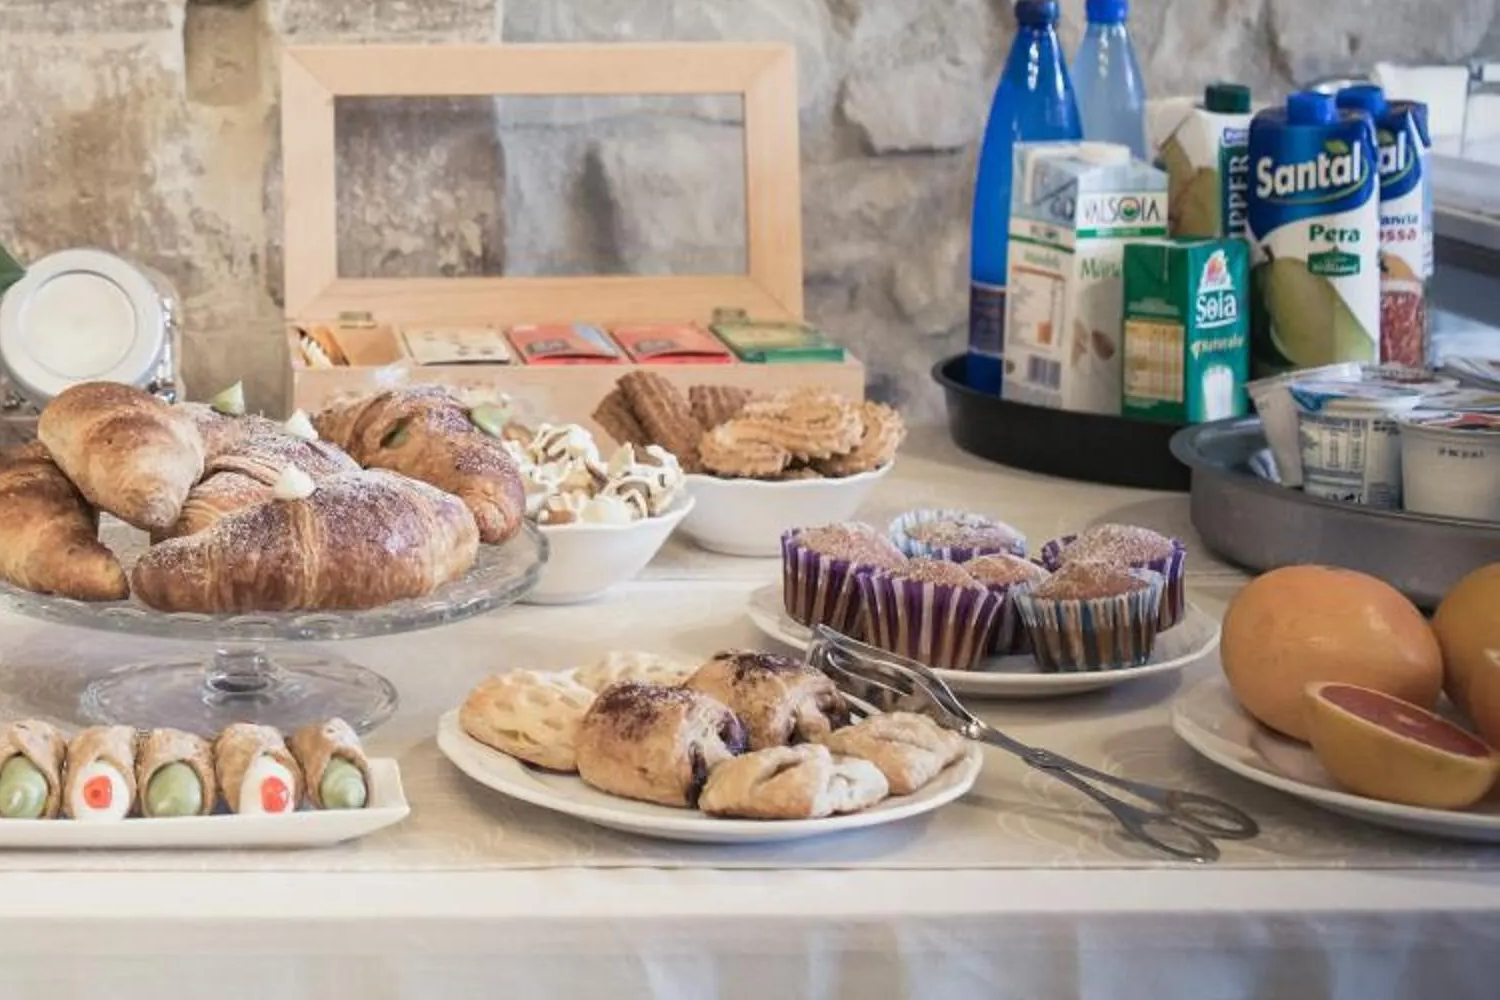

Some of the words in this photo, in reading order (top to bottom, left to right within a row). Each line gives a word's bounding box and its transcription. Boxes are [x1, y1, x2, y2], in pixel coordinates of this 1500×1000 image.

[1228, 154, 1249, 239] IPPER
[1309, 223, 1361, 243] Pera
[1195, 288, 1238, 324] Soia
